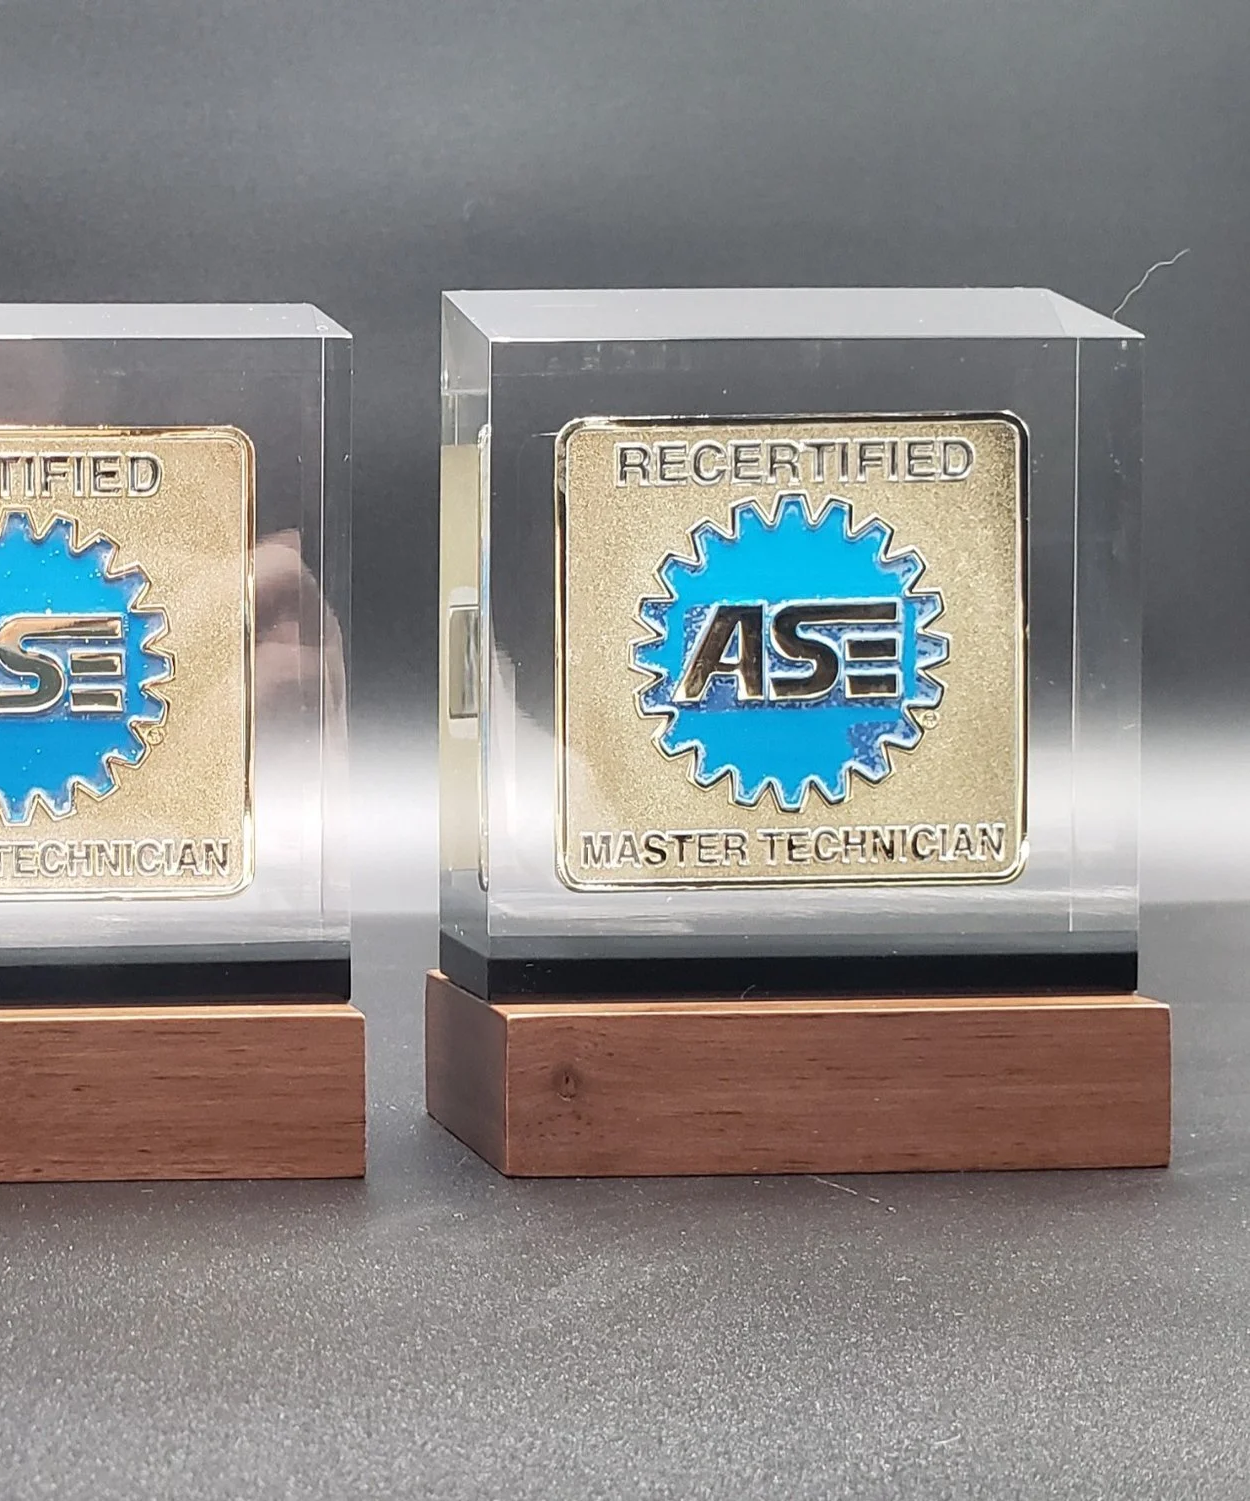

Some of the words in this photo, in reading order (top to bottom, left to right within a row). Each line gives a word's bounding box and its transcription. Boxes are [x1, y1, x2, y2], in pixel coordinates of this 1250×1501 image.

[615, 436, 976, 488] RECERTIFIED
[672, 599, 900, 702] ASE
[580, 829, 748, 870] MASTER
[756, 822, 1006, 866] TECHNICIAN
